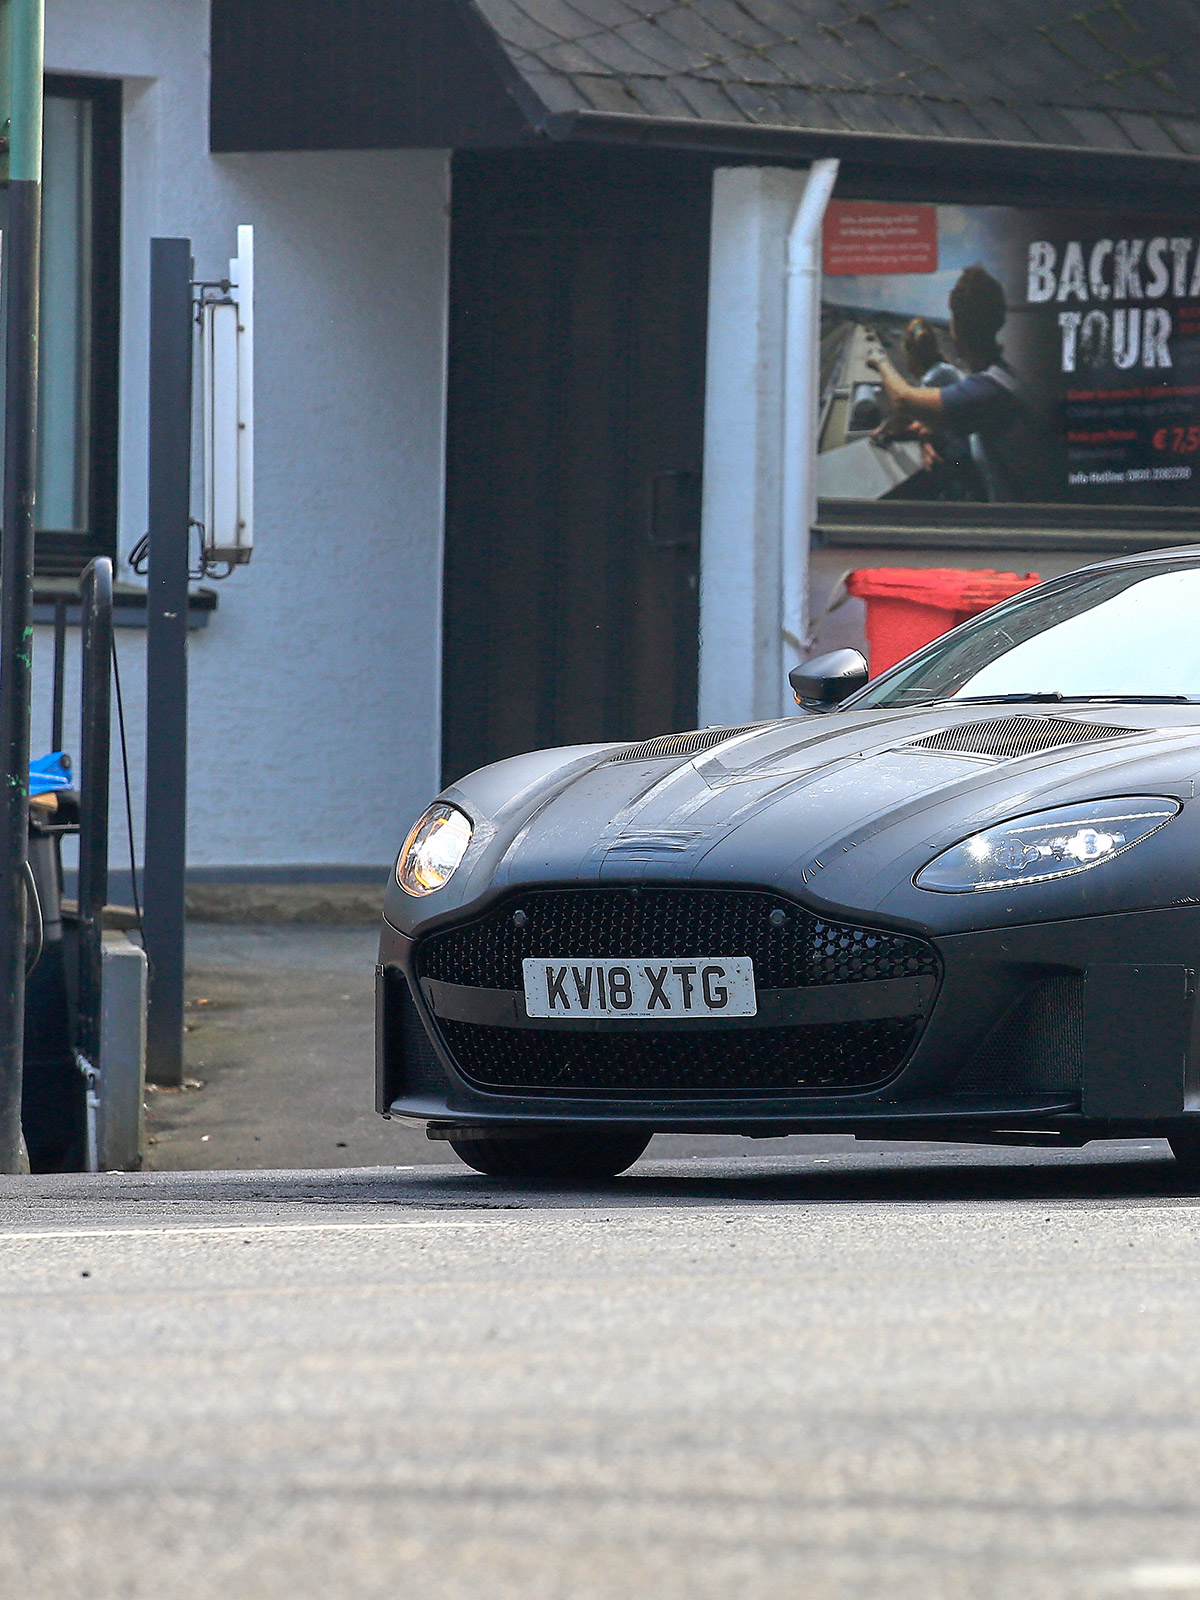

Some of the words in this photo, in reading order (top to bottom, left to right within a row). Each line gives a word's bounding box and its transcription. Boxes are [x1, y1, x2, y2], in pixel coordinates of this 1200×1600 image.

[1058, 307, 1173, 373] TOUR
[545, 966, 634, 1010] KV18
[643, 965, 729, 1010] XTG
